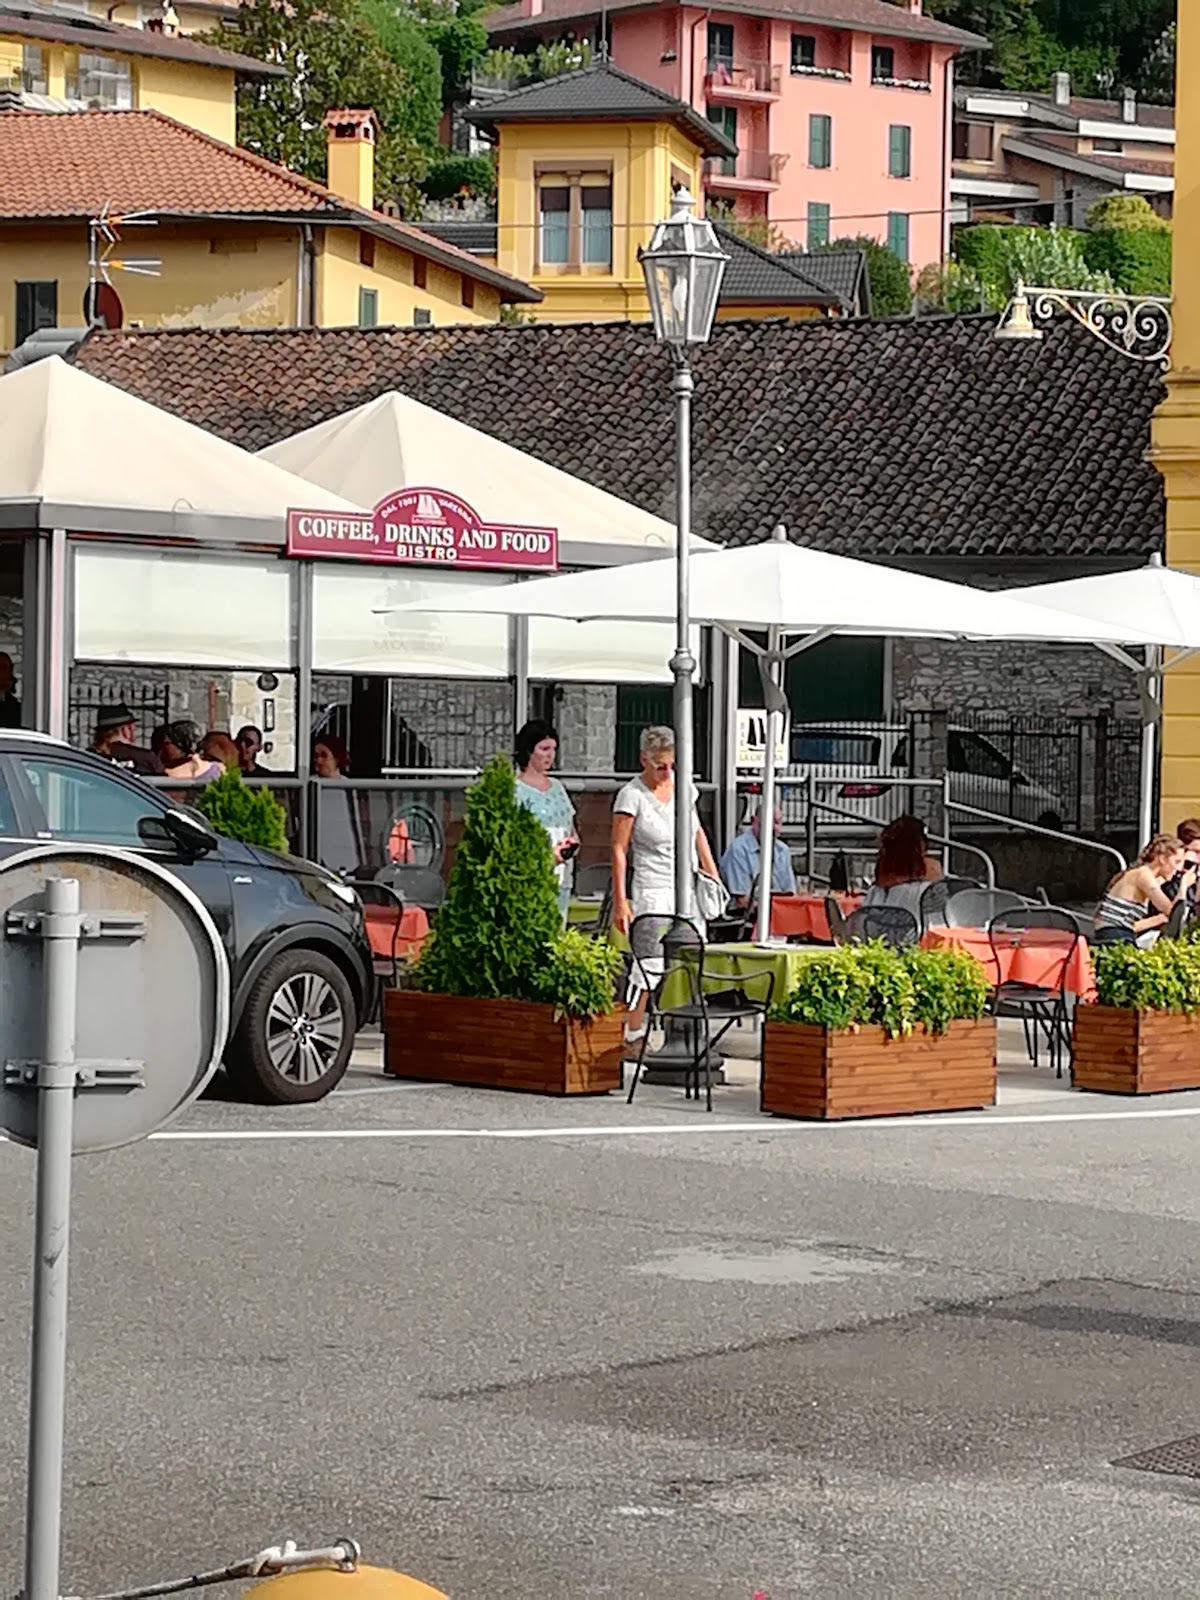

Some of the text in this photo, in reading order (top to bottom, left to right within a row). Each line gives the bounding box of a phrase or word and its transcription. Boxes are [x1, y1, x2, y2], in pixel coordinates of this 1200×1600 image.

[298, 517, 552, 554] COFFEE, DRINKS AND FOOD
[397, 544, 458, 561] BISTRO
